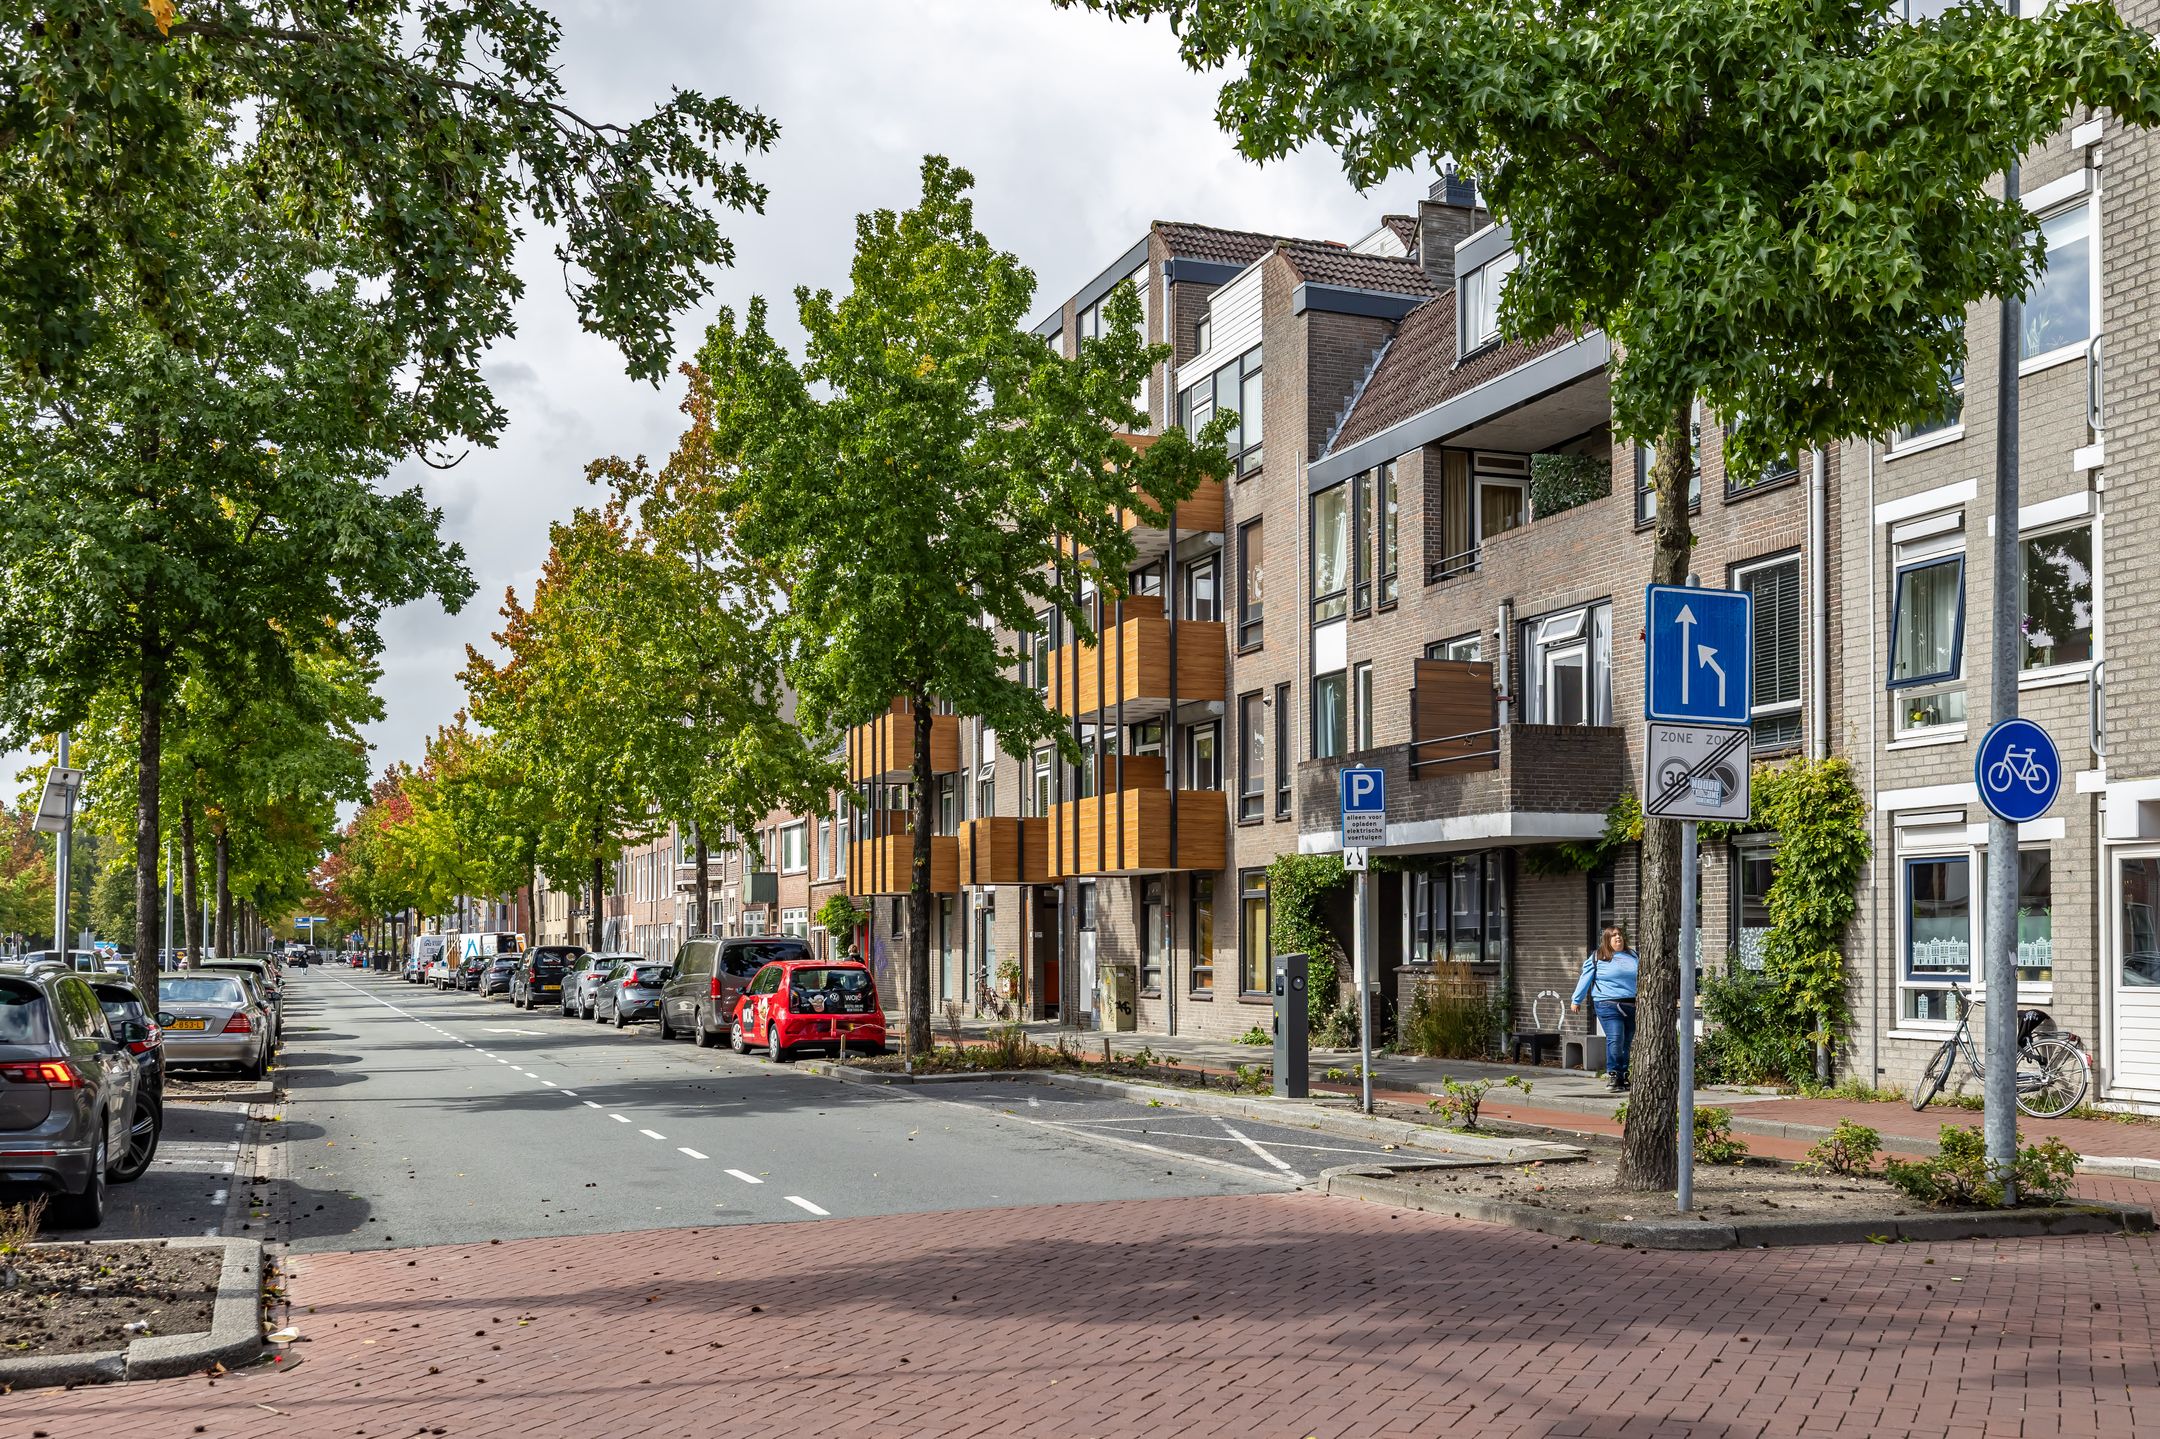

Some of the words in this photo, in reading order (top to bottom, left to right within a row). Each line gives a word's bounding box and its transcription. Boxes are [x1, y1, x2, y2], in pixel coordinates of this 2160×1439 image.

[1660, 731, 1693, 743] ZONE
[1664, 771, 1688, 787] 30
[1352, 774, 1375, 807] P
[170, 1021, 201, 1029] -853-L
